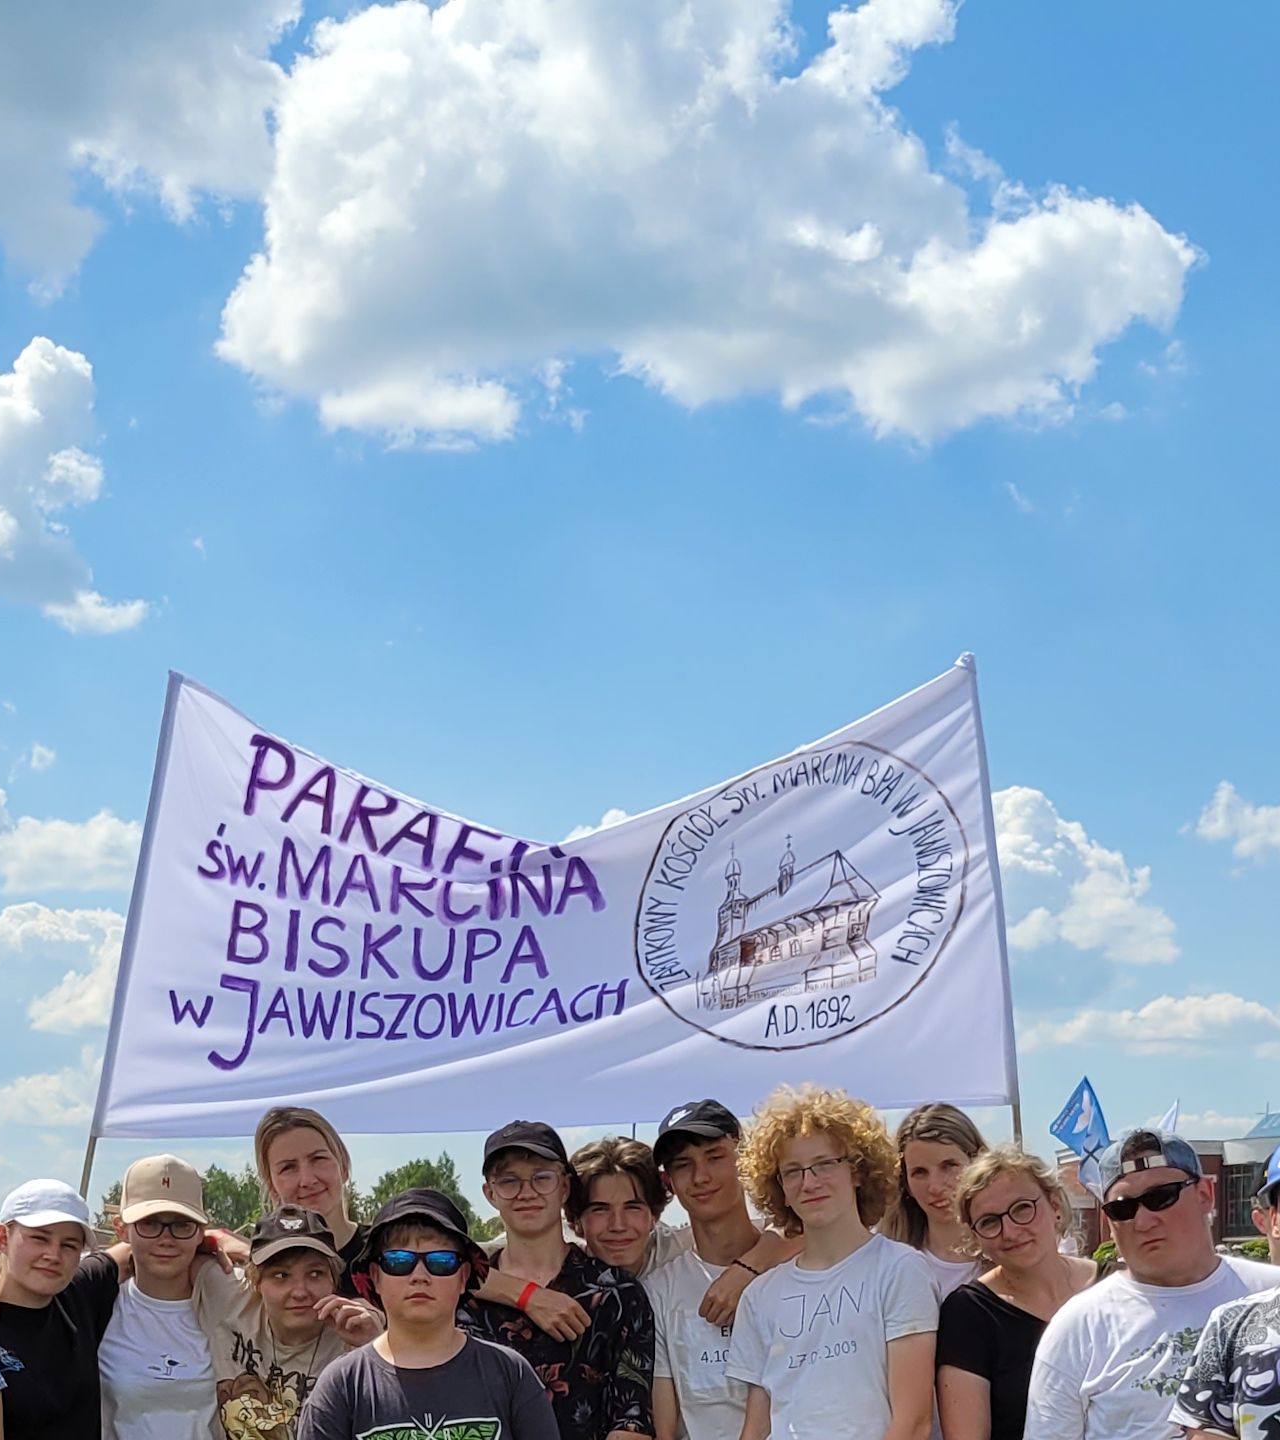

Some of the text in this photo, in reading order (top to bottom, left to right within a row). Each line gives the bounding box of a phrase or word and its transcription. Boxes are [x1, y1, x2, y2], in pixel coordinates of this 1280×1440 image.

[243, 734, 566, 874] PARAFI
[773, 753, 865, 793] MARCINA
[860, 759, 904, 805] BPA
[891, 783, 928, 819] W
[226, 899, 549, 984] BISKUPA
[208, 973, 630, 1071] JAWISZOWICACH
[779, 1281, 864, 1338] JAN
